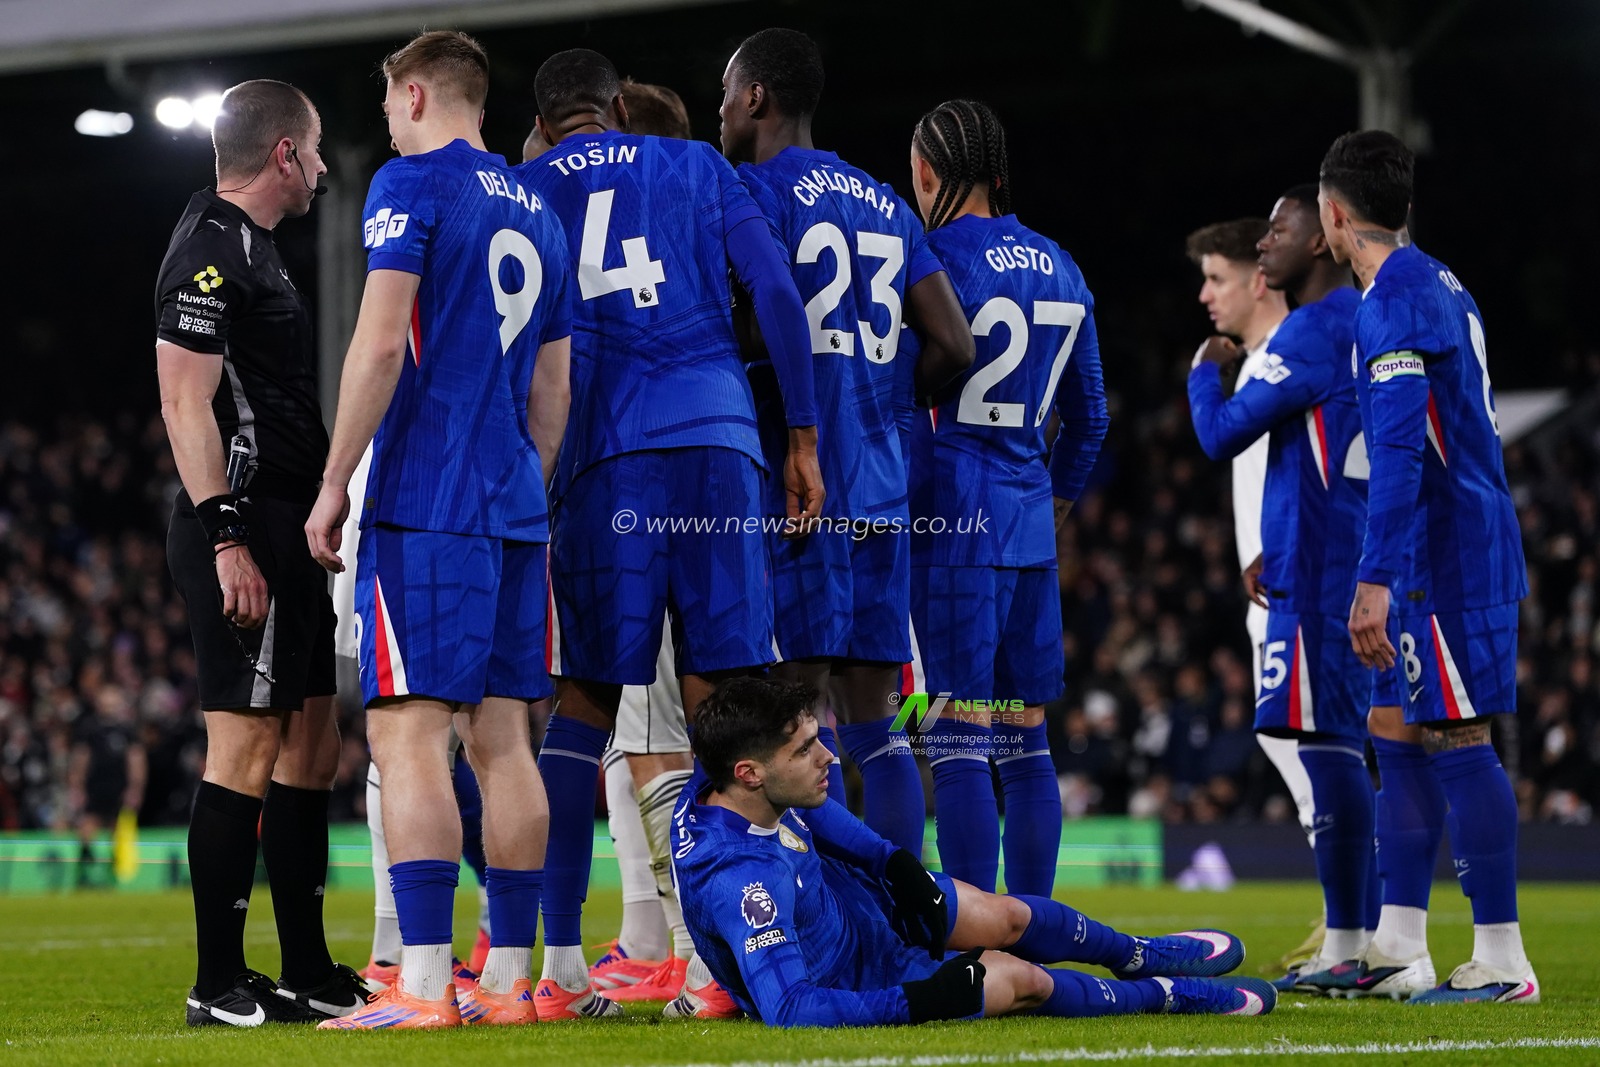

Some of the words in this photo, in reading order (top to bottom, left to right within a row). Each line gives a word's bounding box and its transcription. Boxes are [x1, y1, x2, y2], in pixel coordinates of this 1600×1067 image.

[549, 145, 637, 176] TOSIN
[476, 171, 542, 214] DELAP
[793, 169, 895, 220] CHALOBAH
[577, 188, 666, 309] 4
[985, 245, 1054, 275] GUSTO
[178, 291, 227, 312] HuwsGray
[488, 228, 543, 357] 9
[796, 221, 905, 364] 23
[176, 303, 201, 315] Building
[180, 313, 193, 324] No
[193, 317, 215, 328] room
[178, 320, 191, 330] for
[191, 324, 216, 336] racism
[957, 297, 1085, 428] 27
[1376, 359, 1423, 373] Captain
[1400, 632, 1421, 684] 8
[745, 937, 756, 946] No
[757, 929, 781, 942] room
[745, 944, 757, 954] for
[758, 936, 787, 949] racism
